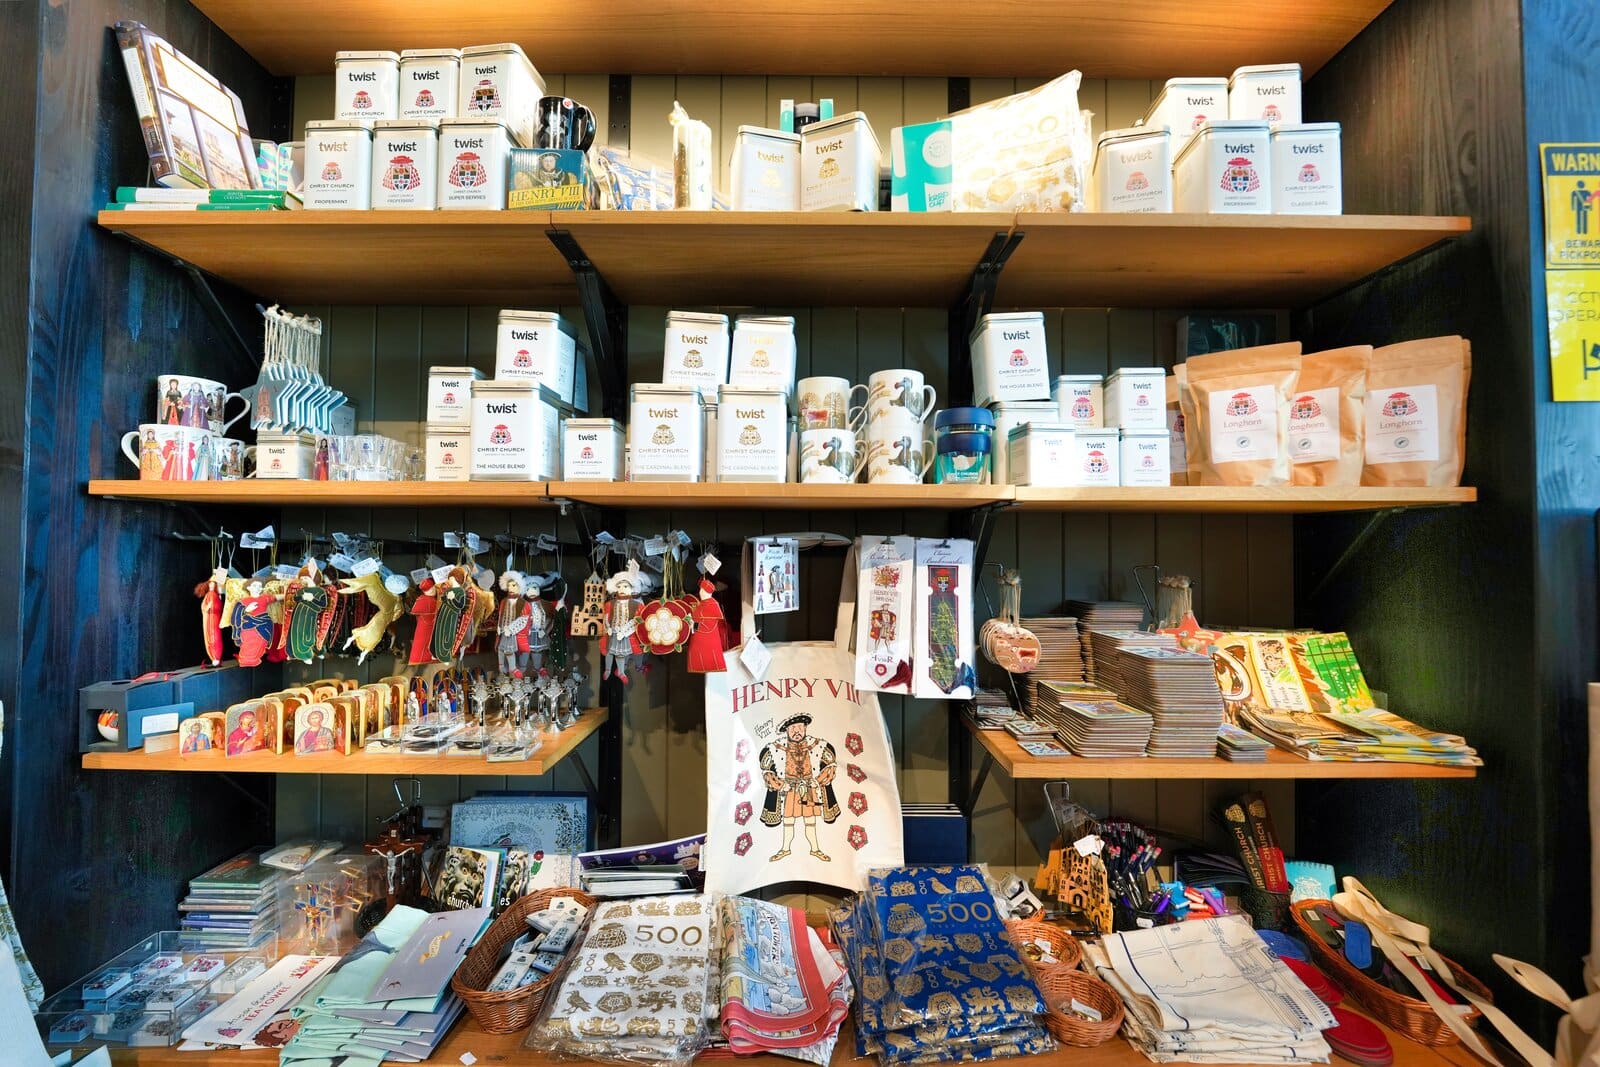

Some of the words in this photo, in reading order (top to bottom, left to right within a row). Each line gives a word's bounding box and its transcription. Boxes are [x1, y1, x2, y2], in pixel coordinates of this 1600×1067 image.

[413, 70, 441, 80] twist
[475, 65, 497, 75] twist
[349, 72, 377, 82] twist
[1257, 86, 1286, 96] twist
[1187, 96, 1214, 106] twist
[319, 141, 349, 152] twist
[388, 142, 418, 152] twist
[454, 138, 485, 150] twist
[816, 140, 844, 155] twist
[1224, 144, 1256, 154] twist
[1292, 144, 1325, 154] twist
[511, 330, 538, 341] twist
[682, 334, 709, 345] twist
[1003, 330, 1031, 341] twist
[486, 404, 518, 414] twist
[649, 408, 679, 418] twist
[736, 408, 766, 419] twist
[731, 678, 820, 714] HENRY
[1234, 827, 1255, 866] CHURCH
[926, 902, 992, 922] 500
[634, 925, 702, 946] 500
[260, 985, 291, 1010] TOWEL
